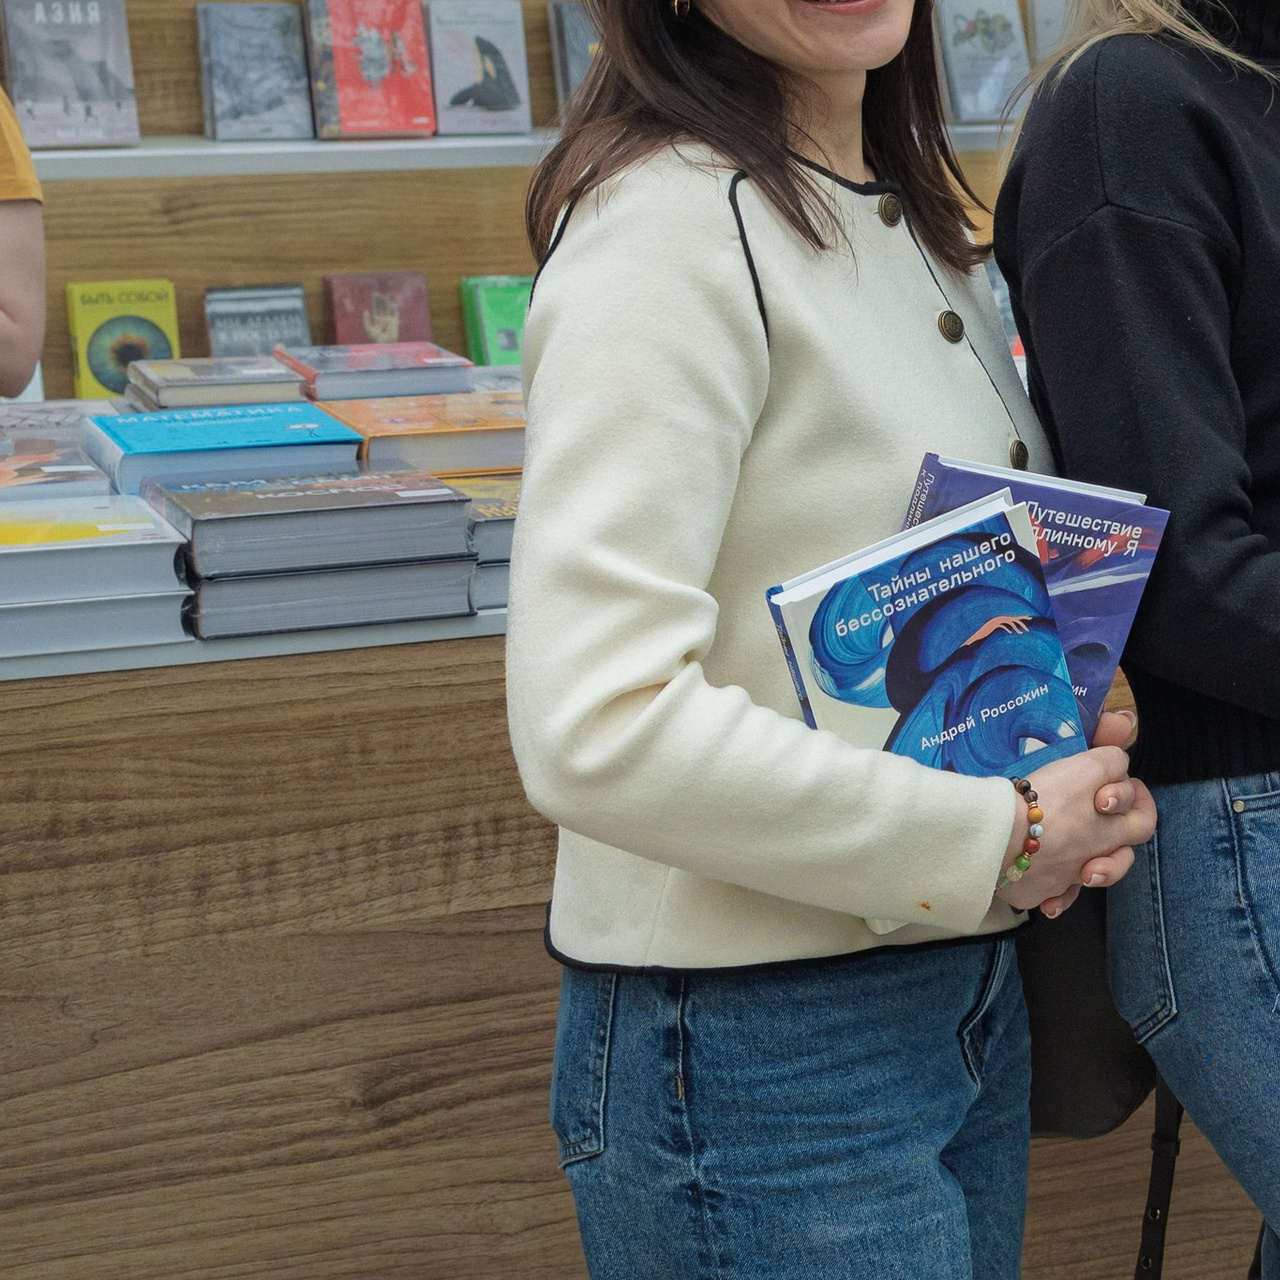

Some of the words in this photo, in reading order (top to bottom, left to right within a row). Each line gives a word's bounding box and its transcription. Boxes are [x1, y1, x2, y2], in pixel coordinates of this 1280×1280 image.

[35, 0, 100, 24] АЗИЯ
[116, 406, 304, 424] МАТЕМАТИКА
[911, 472, 935, 529] Путешес
[1027, 501, 1143, 539] Путешествие
[868, 565, 932, 604] Тайны
[939, 531, 1012, 573] нашего
[1123, 539, 1139, 557] Я
[834, 549, 1017, 638] бессознательного
[920, 715, 976, 752] Андрей
[980, 683, 1050, 723] Россохин
